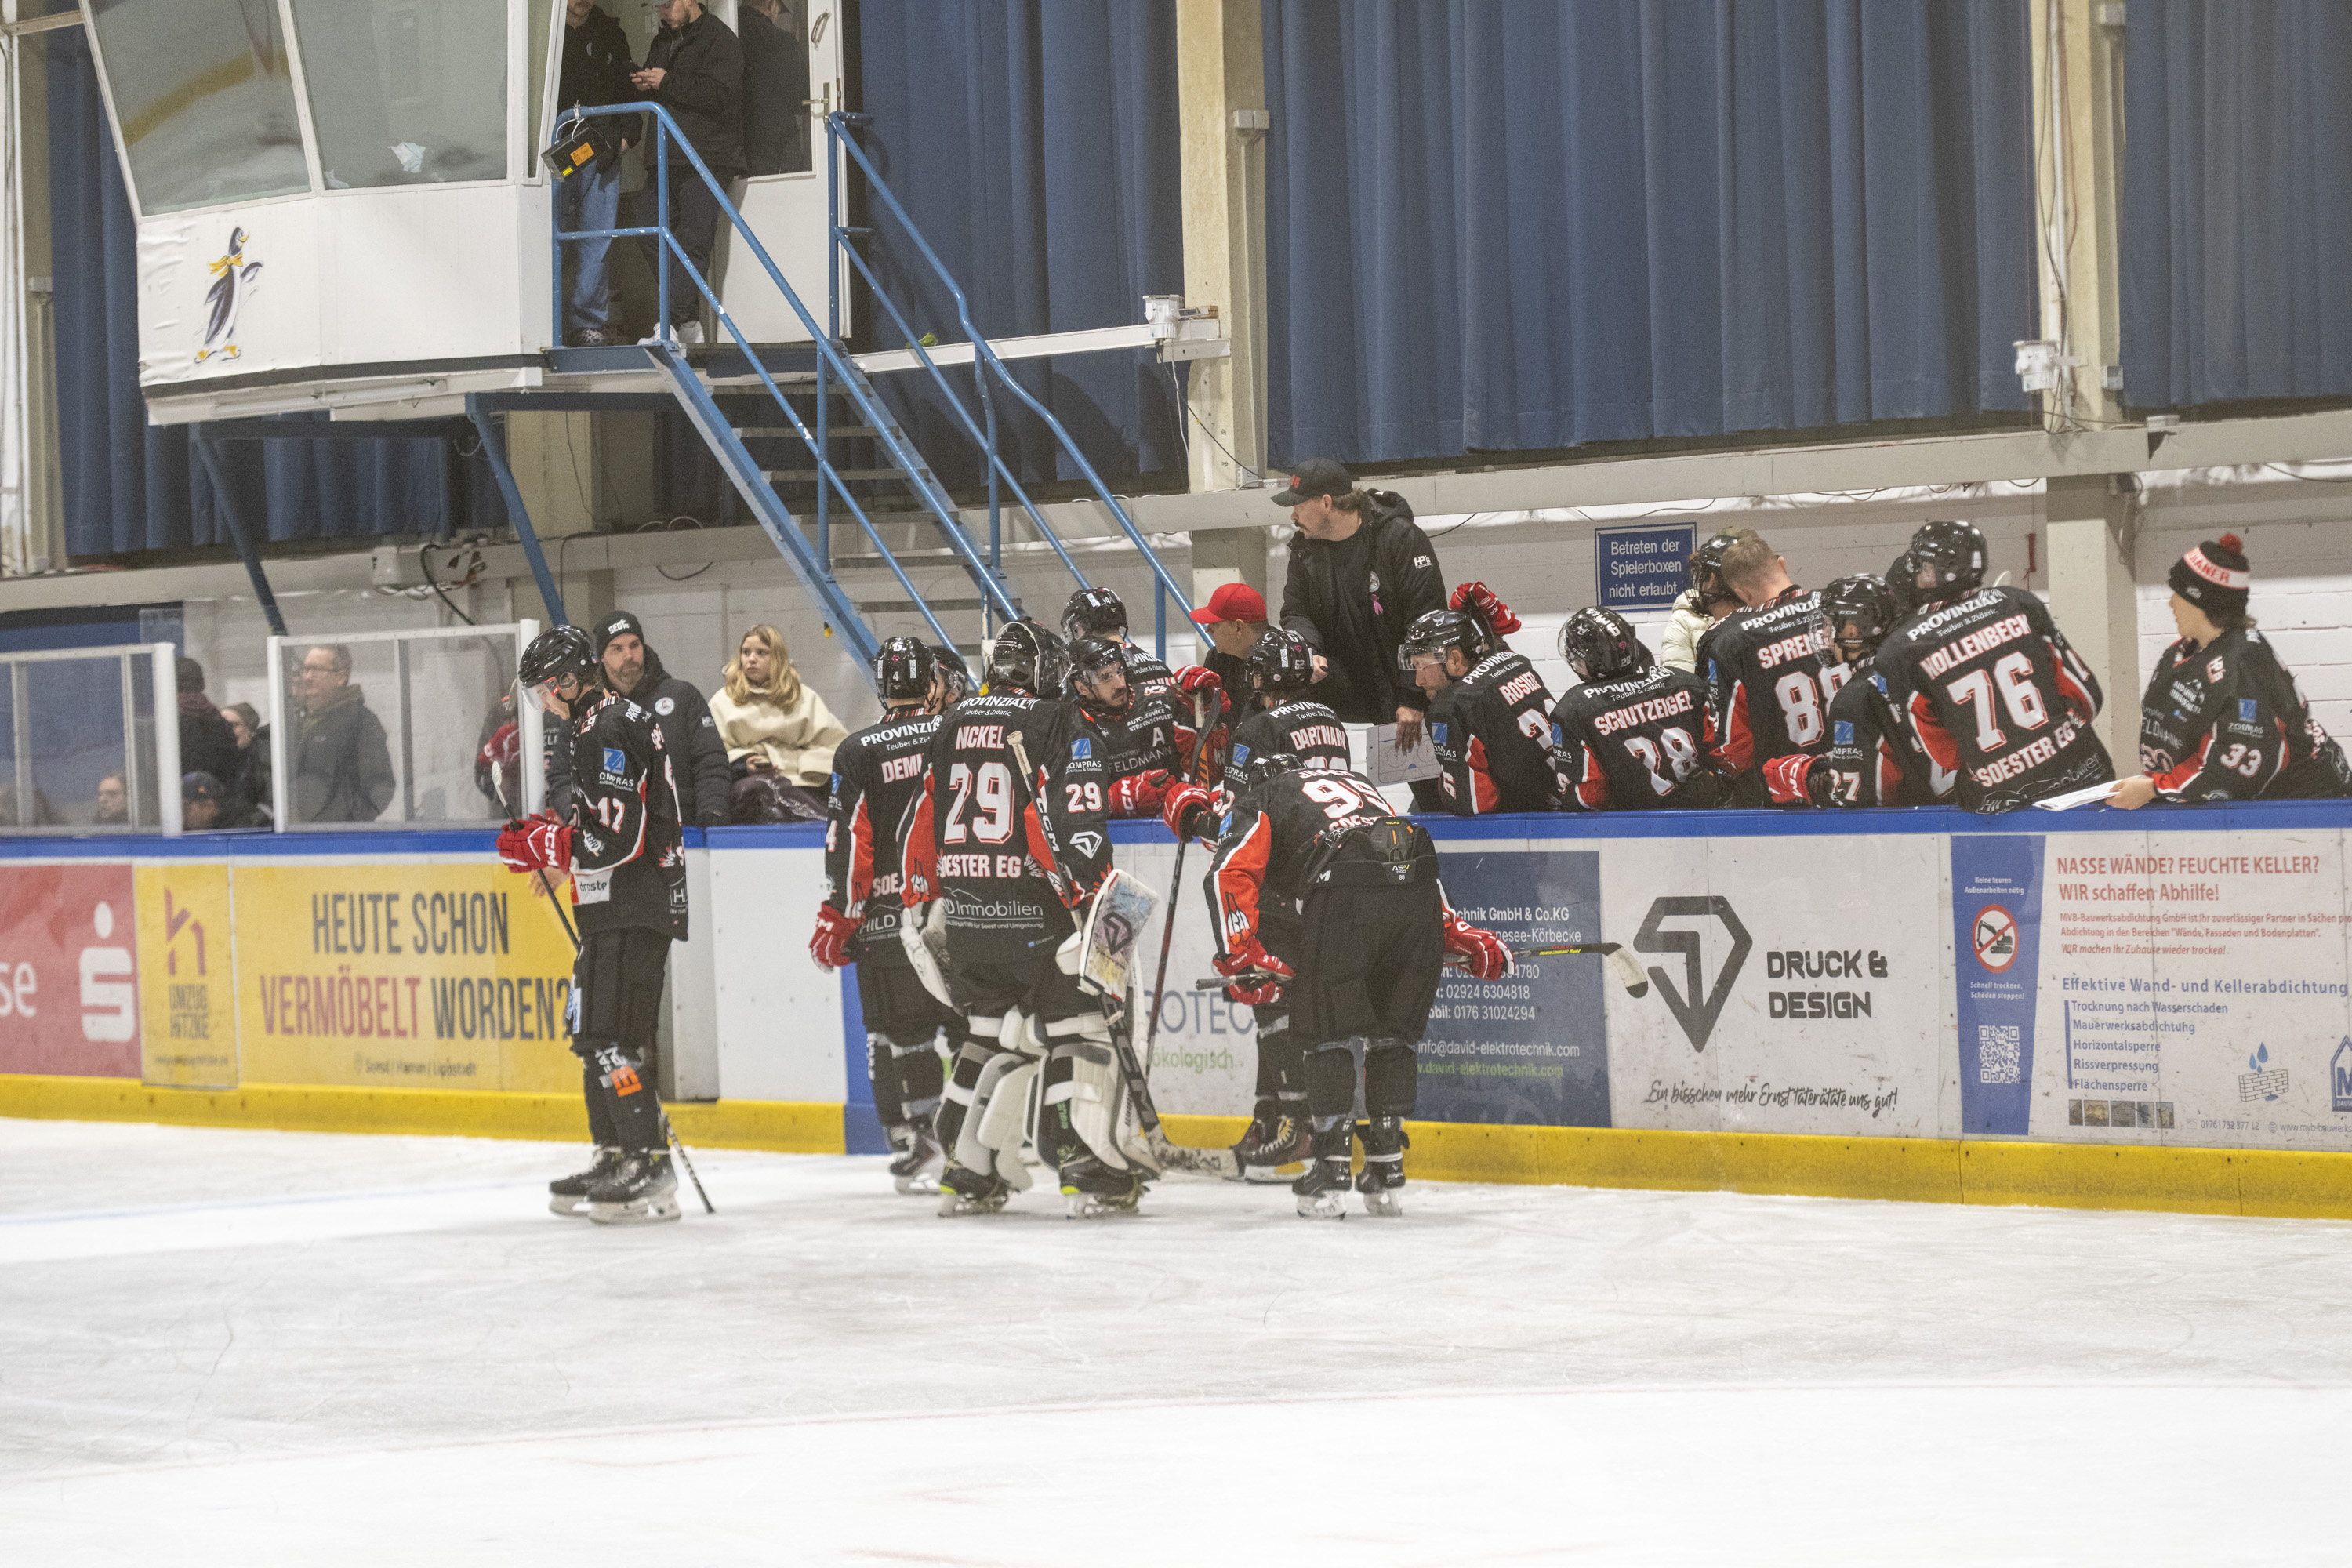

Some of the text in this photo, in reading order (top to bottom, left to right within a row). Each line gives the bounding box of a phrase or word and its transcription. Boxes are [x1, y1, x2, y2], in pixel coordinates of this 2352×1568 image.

[1610, 538, 1680, 555] Betreten der
[1610, 559, 1682, 578] Spielerboxen
[1609, 581, 1678, 598] nicht erlaubt
[1907, 595, 2004, 641] PROVINZIAL
[1769, 622, 1795, 633] Teuber
[1937, 621, 1964, 637] Teuber
[1443, 636, 1461, 644] CCM
[892, 671, 899, 681] 4
[1499, 671, 1541, 706] ROSIER
[1610, 691, 1635, 702] Teuber
[956, 695, 1029, 710] PROVINZIAL
[1946, 652, 2049, 753] 76
[989, 708, 1012, 717] Zidaric
[1296, 711, 1318, 720] Teuber
[1594, 690, 1693, 736] SCHUTZEIGEL
[860, 721, 941, 747] PROVINZIA
[955, 725, 1004, 750] NICKEL
[1152, 727, 1165, 746] A
[885, 741, 911, 751] Teuber
[1976, 736, 2057, 788] SOESTER
[2053, 720, 2076, 749] EG
[1624, 727, 1700, 797] 28
[2220, 743, 2262, 777] 33
[943, 761, 1014, 845] 29
[1065, 782, 1102, 814] 29
[1036, 797, 1060, 852] CCM
[996, 855, 1022, 879] EG
[2057, 853, 2320, 875] NASSE WÄNDE? FEUCHTE KELLER?
[579, 880, 607, 892] droste
[2009, 886, 2025, 895] nötig
[2059, 882, 2220, 901] WIR schaffen Abhilfe!
[956, 899, 1044, 916] Immobilien
[1459, 906, 1570, 922] chnik GmbH & Co.KG
[313, 892, 510, 956] HEUTE SCHON
[2060, 913, 2336, 925] MVB-Bauwerksabdichtung GmbH ist Ihr zuverlässiger Partner in Sachen
[2060, 927, 2104, 938] Abdichtung
[2106, 927, 2114, 937] in
[2116, 927, 2130, 937] den
[2132, 927, 2170, 937] Bereichen
[2205, 928, 2241, 938] Fassaden
[2243, 928, 2259, 938] und
[2061, 943, 2227, 955] WIR machen Ihr Zuhause wieder trocken!
[1231, 953, 1248, 967] CCM
[1767, 949, 1889, 979] DRUCK &
[1446, 985, 1530, 1000] 02924 6304818
[1998, 992, 2025, 1000] stoppen!
[2063, 977, 2349, 998] Effektive Wand- und Kellerabdichtung
[260, 965, 421, 1040] VERMÖBELT
[1769, 991, 1872, 1019] DESIGN
[2071, 1000, 2229, 1014] Trocknung nach Wasserschaden
[1428, 1005, 1536, 1021] obil: 0176 31024294
[2073, 1019, 2196, 1036] Mauerwerksabdichtung
[1417, 1040, 1581, 1057] info@david-elektrotechnik.com
[2074, 1039, 2161, 1053] Horizontalsperre
[1152, 1046, 1234, 1075] ökologisch
[2074, 1058, 2159, 1074] Rissverpressung
[2074, 1078, 2148, 1093] Flächensperre
[1643, 1079, 1668, 1103] Ein
[1671, 1080, 1722, 1105] bisschen
[1726, 1083, 1759, 1104] mehr
[1849, 1094, 1871, 1110] uns
[1871, 1087, 1899, 1119] gut!
[2200, 1120, 2218, 1130] 0176
